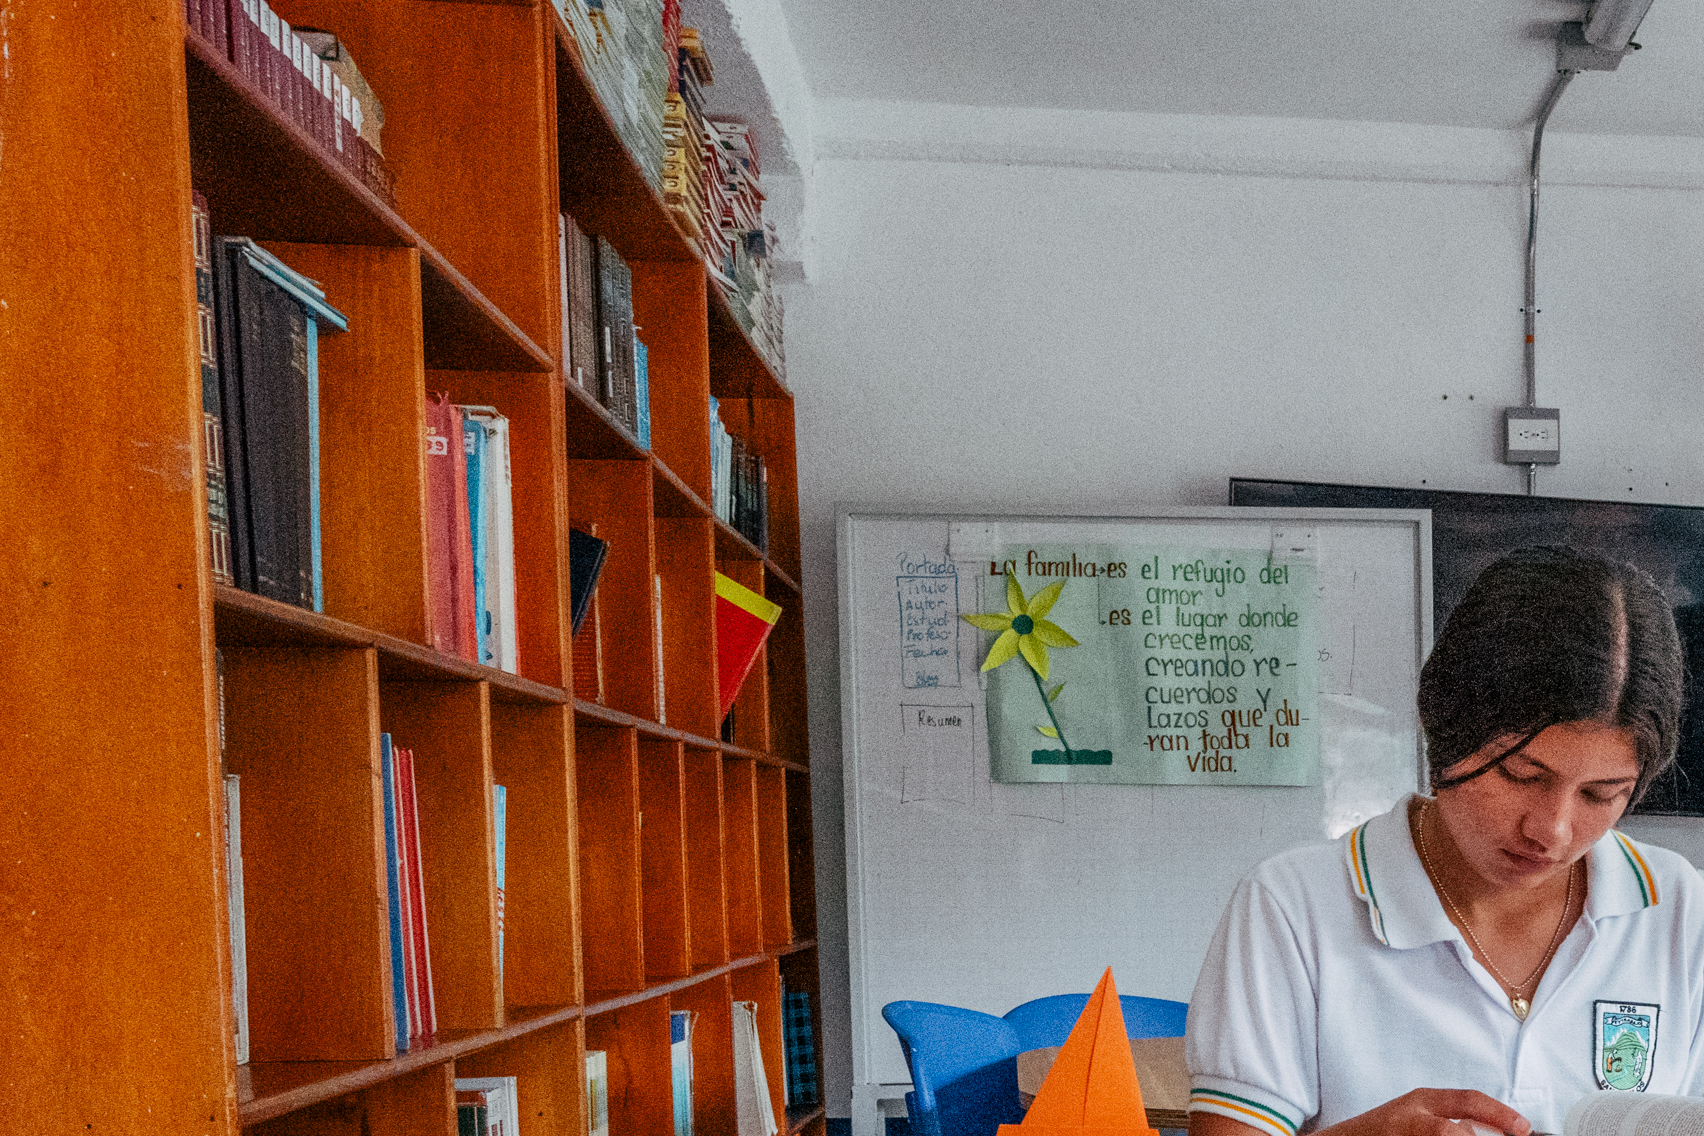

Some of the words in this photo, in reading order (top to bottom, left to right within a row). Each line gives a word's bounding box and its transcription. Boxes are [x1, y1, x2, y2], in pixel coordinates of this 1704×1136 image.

[990, 559, 1016, 576] La
[1025, 550, 1096, 577] familia
[1106, 562, 1128, 578] es
[1141, 555, 1159, 580] el
[1172, 560, 1246, 597] refugio
[1260, 556, 1289, 584] del
[1146, 586, 1203, 605] amor
[1109, 608, 1131, 626] es
[1141, 605, 1160, 627] el
[1176, 606, 1228, 639] lugar
[1238, 604, 1298, 628] donde
[1144, 632, 1254, 653] crecemos,
[1145, 650, 1246, 677] creando
[1145, 680, 1238, 704] cuerdos
[918, 709, 962, 728] Resumen
[1221, 708, 1263, 737] que
[1198, 728, 1250, 750] toda
[1269, 725, 1289, 748] la
